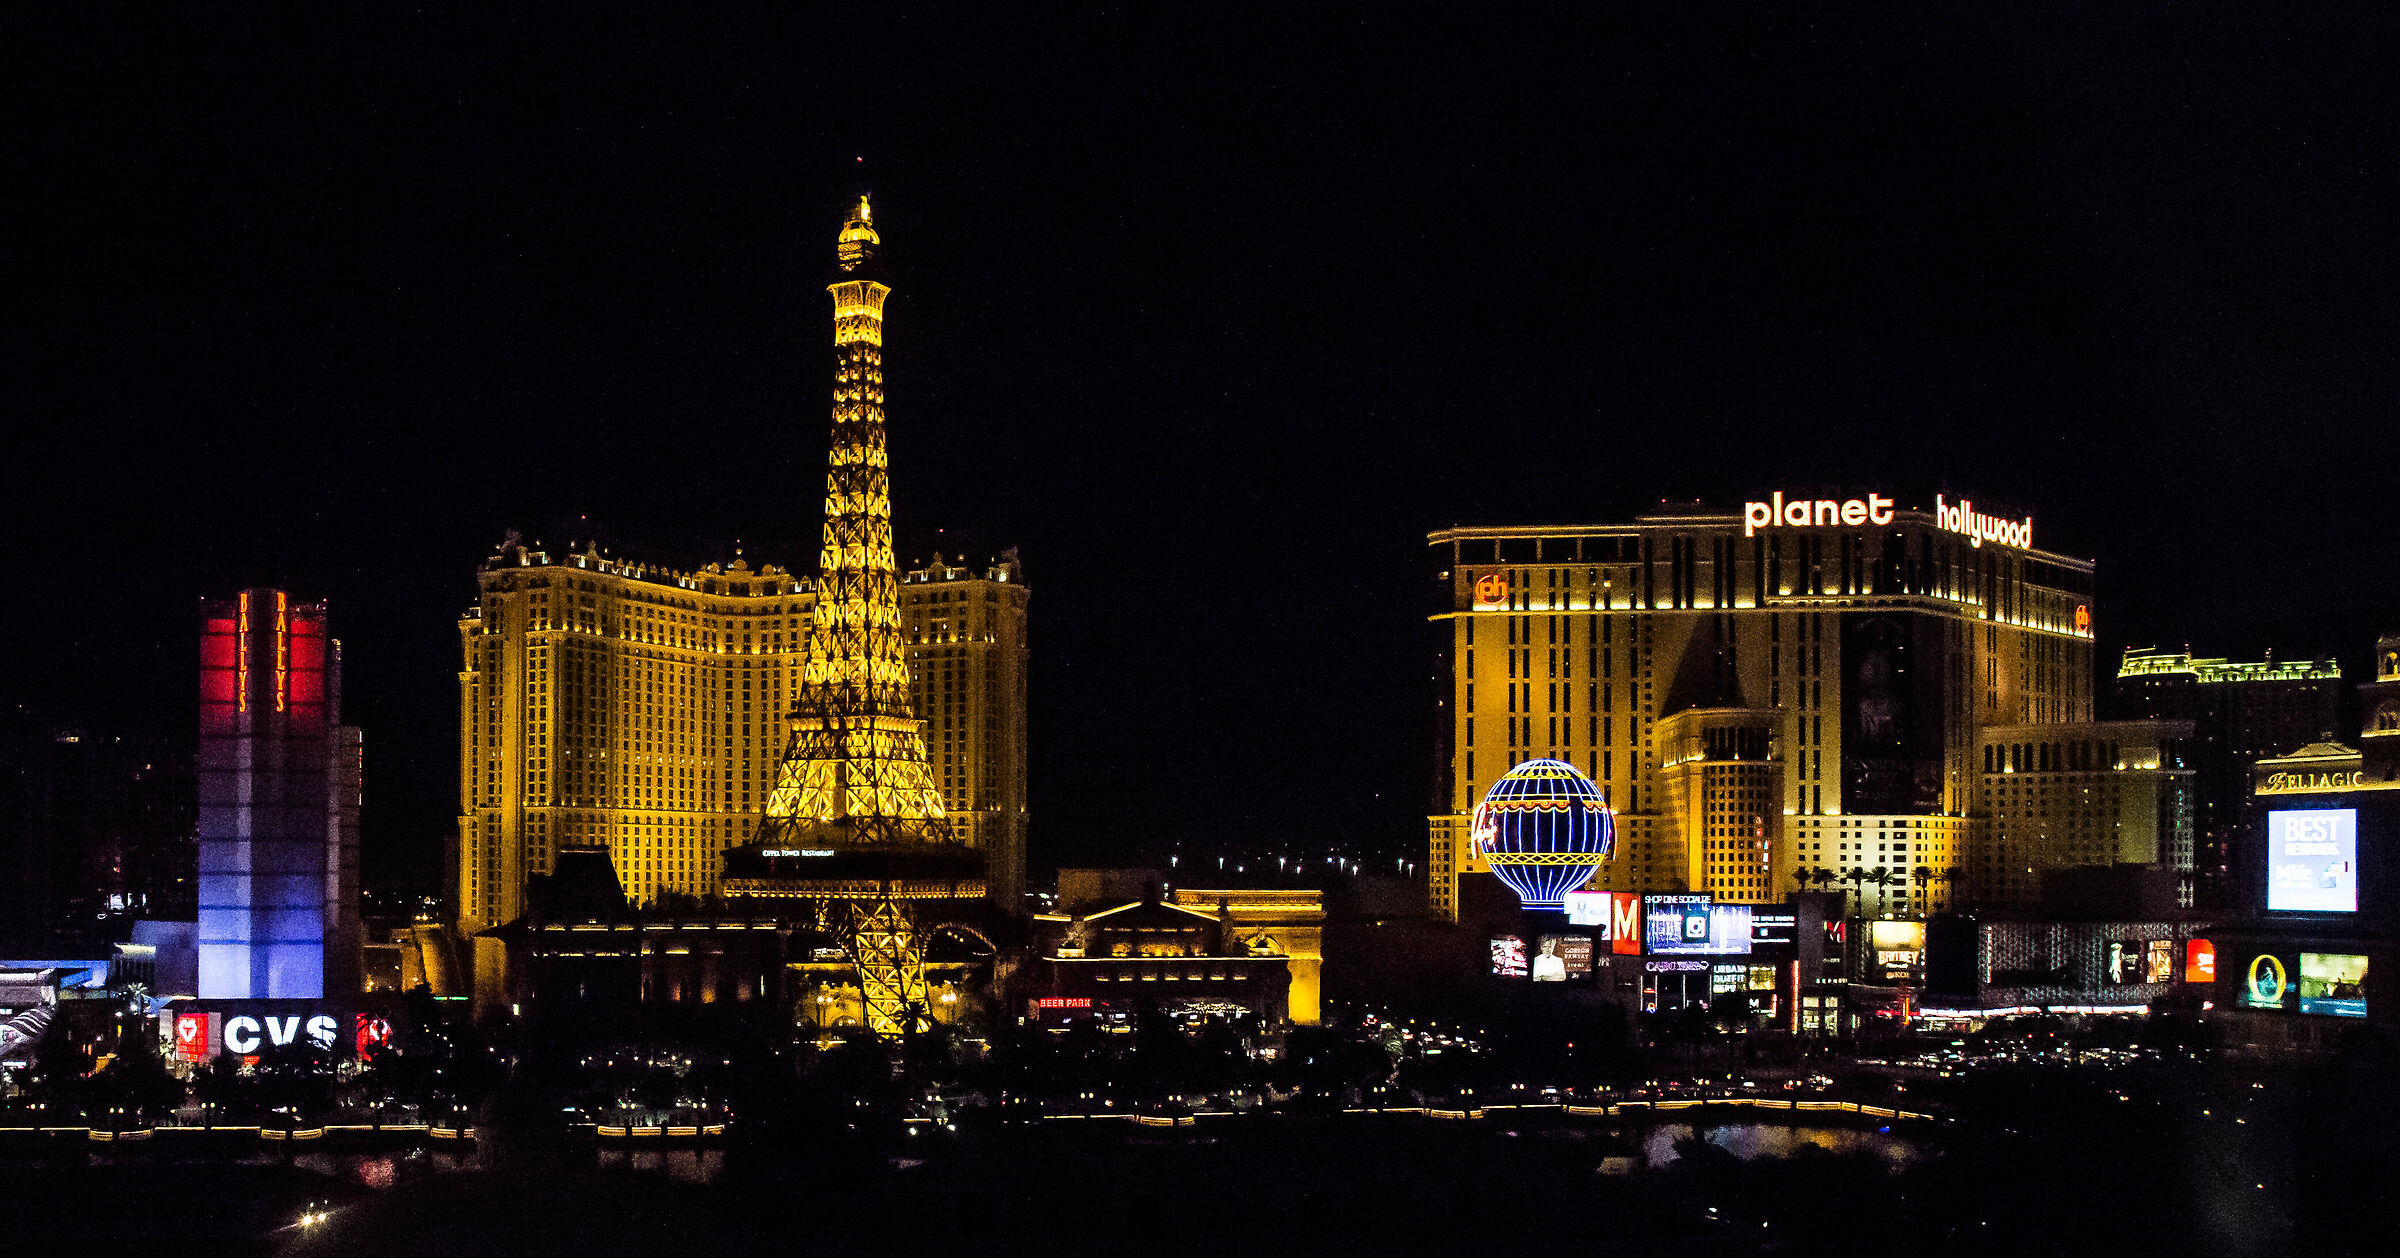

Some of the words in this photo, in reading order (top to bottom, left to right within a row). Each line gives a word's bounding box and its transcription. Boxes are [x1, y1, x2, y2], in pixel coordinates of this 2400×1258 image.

[1745, 491, 1894, 537] planet
[1937, 494, 2032, 548] hollywood
[2284, 816, 2341, 842] BEST
[1614, 899, 1638, 941] M
[1713, 965, 1747, 974] URBAN
[1040, 998, 1064, 1008] BEER
[1066, 998, 1091, 1008] PARK
[224, 1015, 338, 1055] CVS
